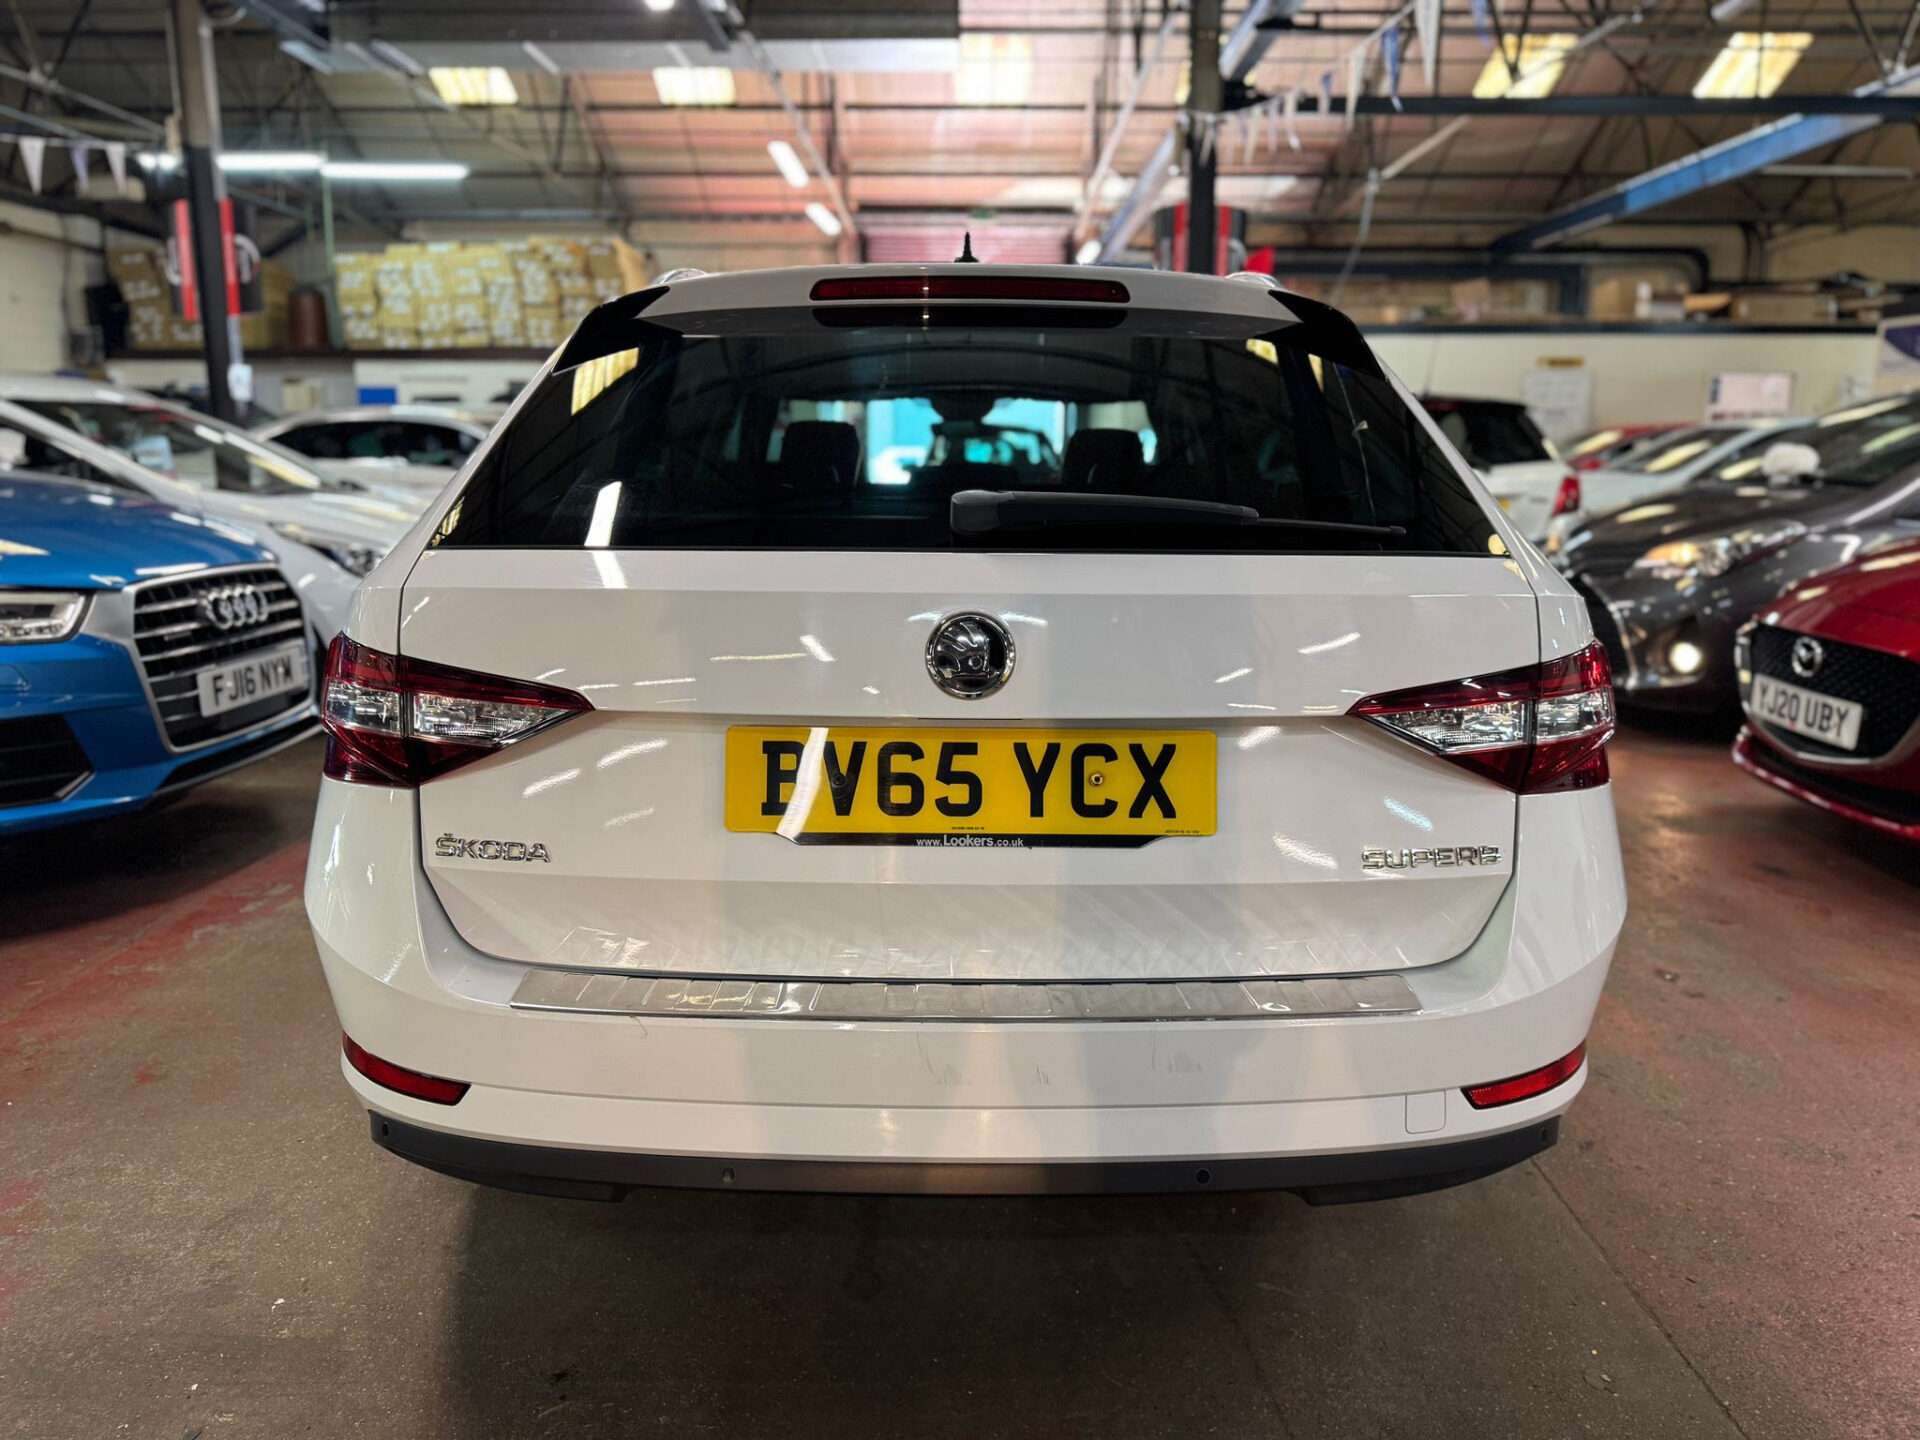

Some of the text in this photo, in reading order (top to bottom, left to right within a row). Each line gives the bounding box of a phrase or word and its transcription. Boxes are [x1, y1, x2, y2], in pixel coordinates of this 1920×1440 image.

[1804, 697, 1850, 737] UBY
[761, 741, 1177, 819] BV65 YCX
[435, 833, 551, 863] ŠKODA
[916, 834, 1024, 847] www.Lookers.co.uk
[1361, 846, 1502, 869] SUPERB
